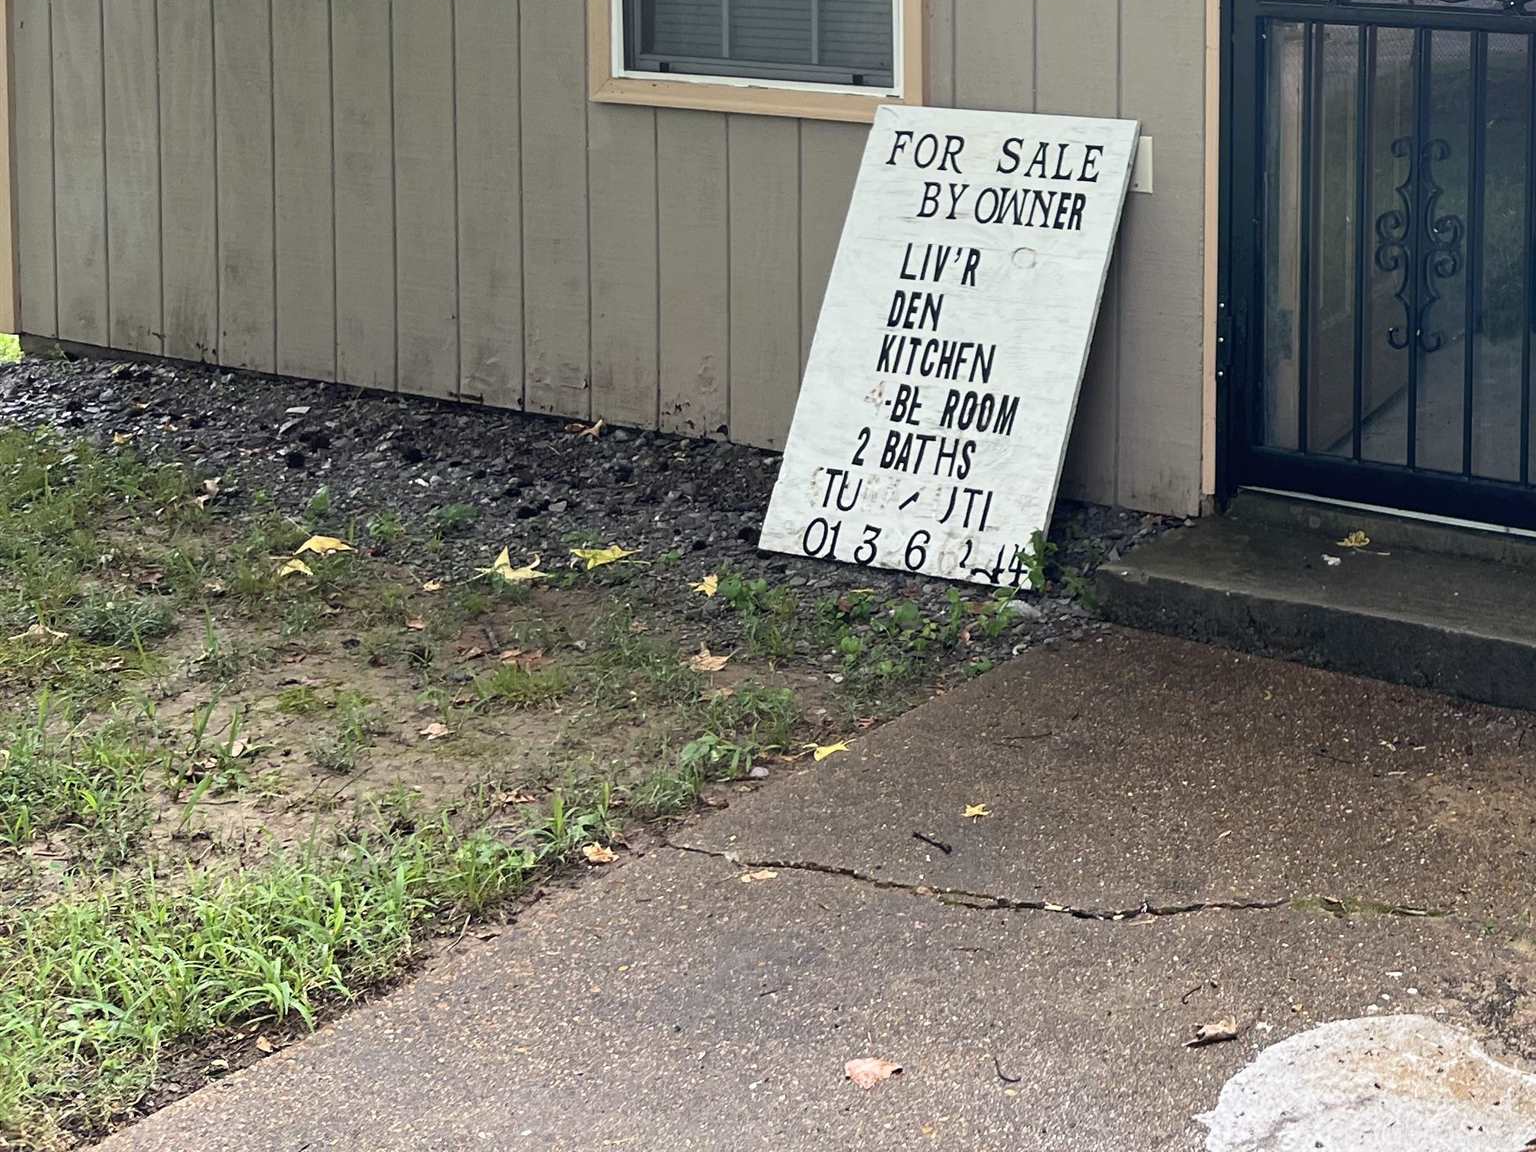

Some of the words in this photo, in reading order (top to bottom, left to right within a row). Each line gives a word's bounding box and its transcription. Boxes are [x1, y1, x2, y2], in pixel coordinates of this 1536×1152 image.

[886, 130, 965, 174] FOR
[997, 137, 1104, 183] SALE
[917, 181, 969, 220] BY
[975, 187, 1087, 231] OWNER
[900, 242, 981, 287] LIV'R
[887, 289, 944, 331] DEN
[940, 388, 1020, 436] ROOM
[851, 426, 872, 466] 2
[880, 429, 977, 480] BATHS
